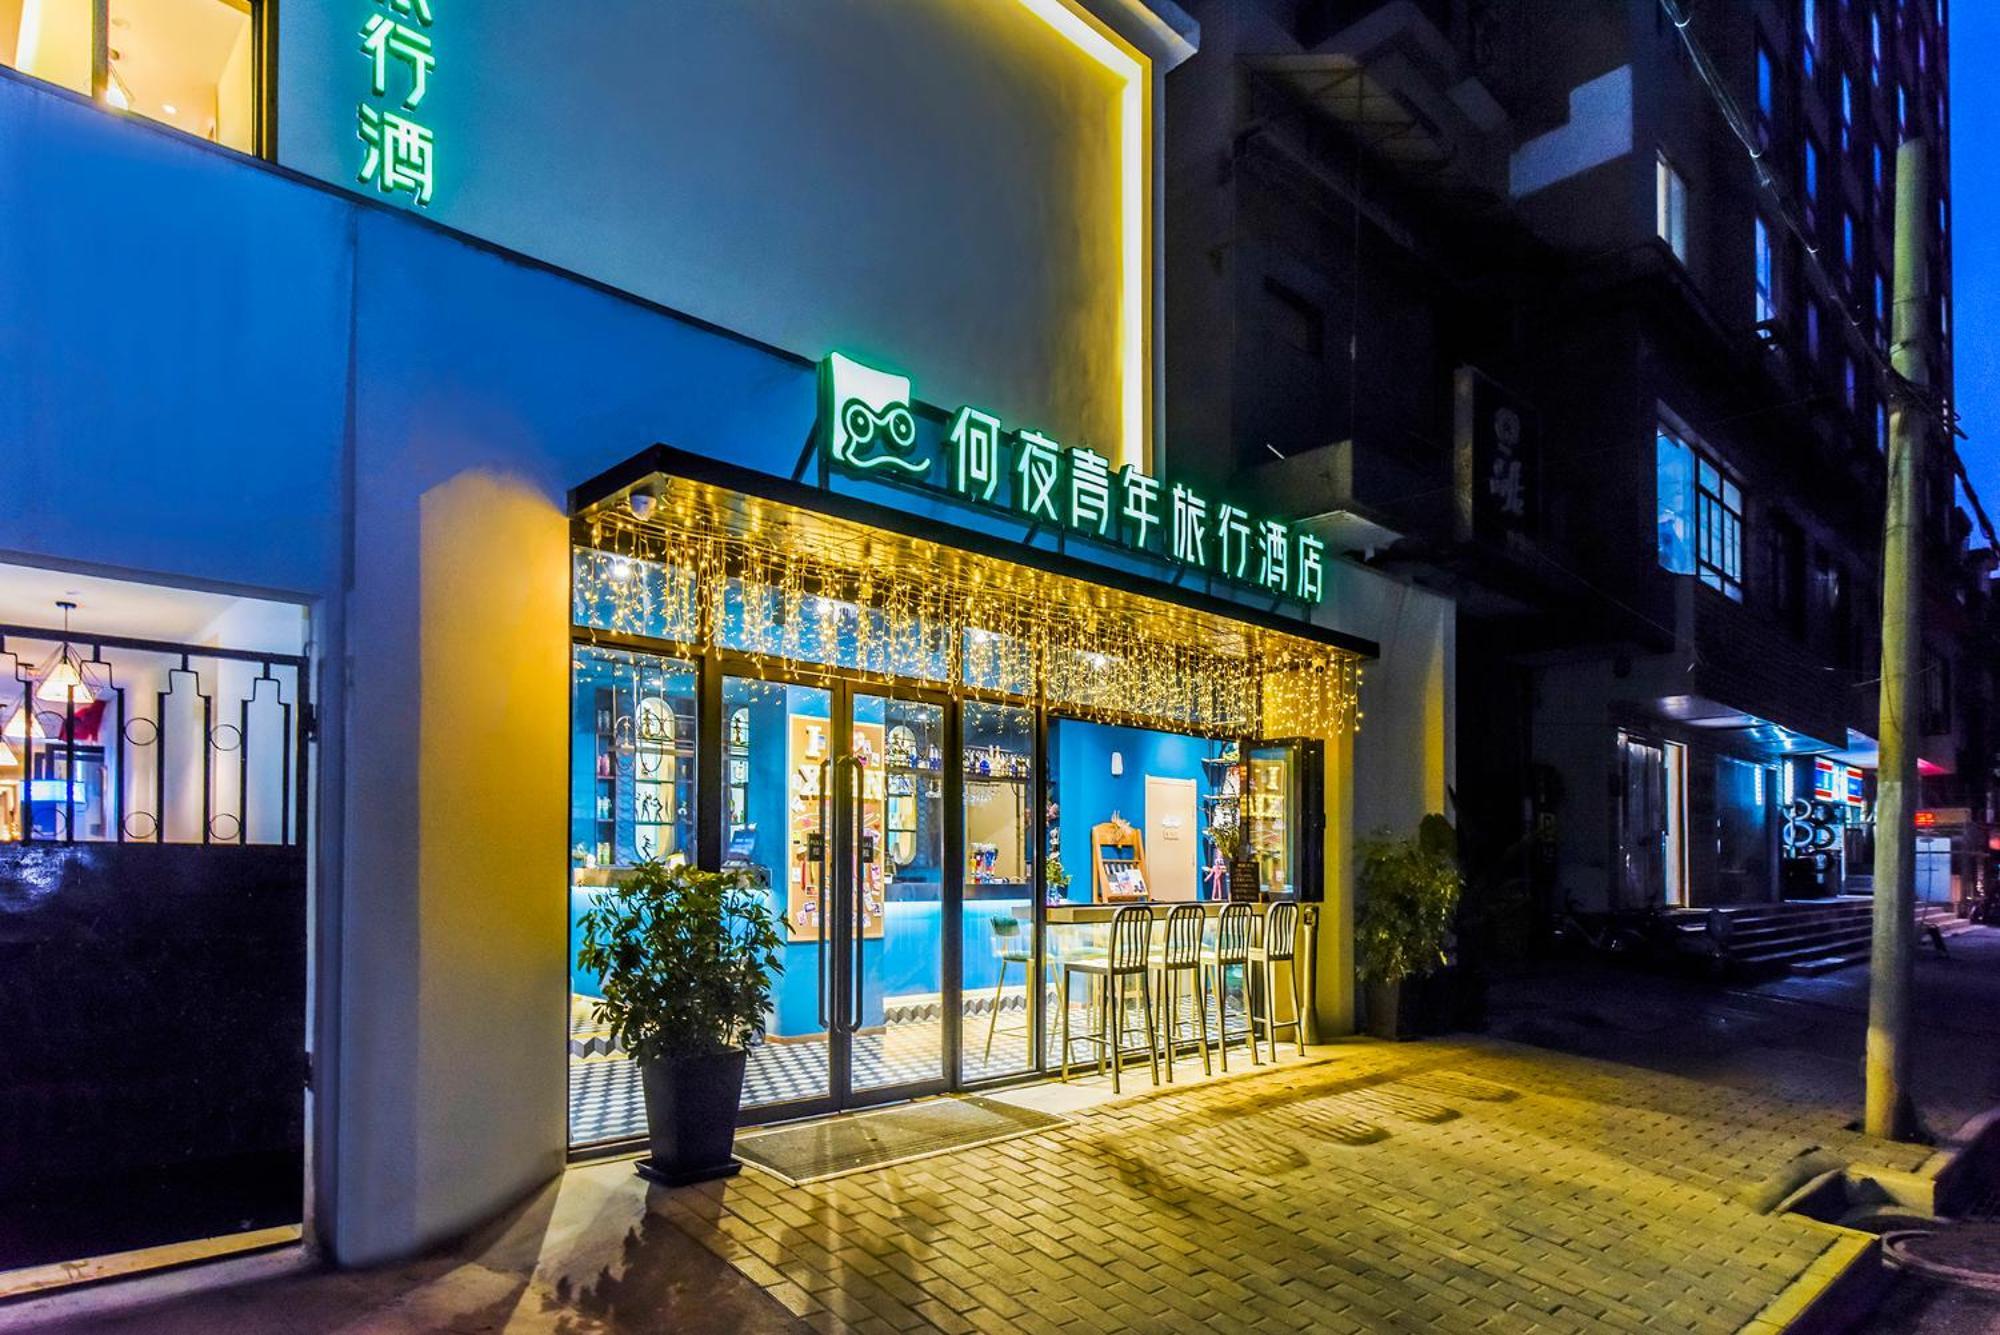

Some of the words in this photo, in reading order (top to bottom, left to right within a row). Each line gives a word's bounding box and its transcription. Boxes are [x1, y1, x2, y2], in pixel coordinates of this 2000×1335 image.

[358, 0, 436, 205] 行酒
[949, 405, 1325, 603] 何夜青年旅行酒店
